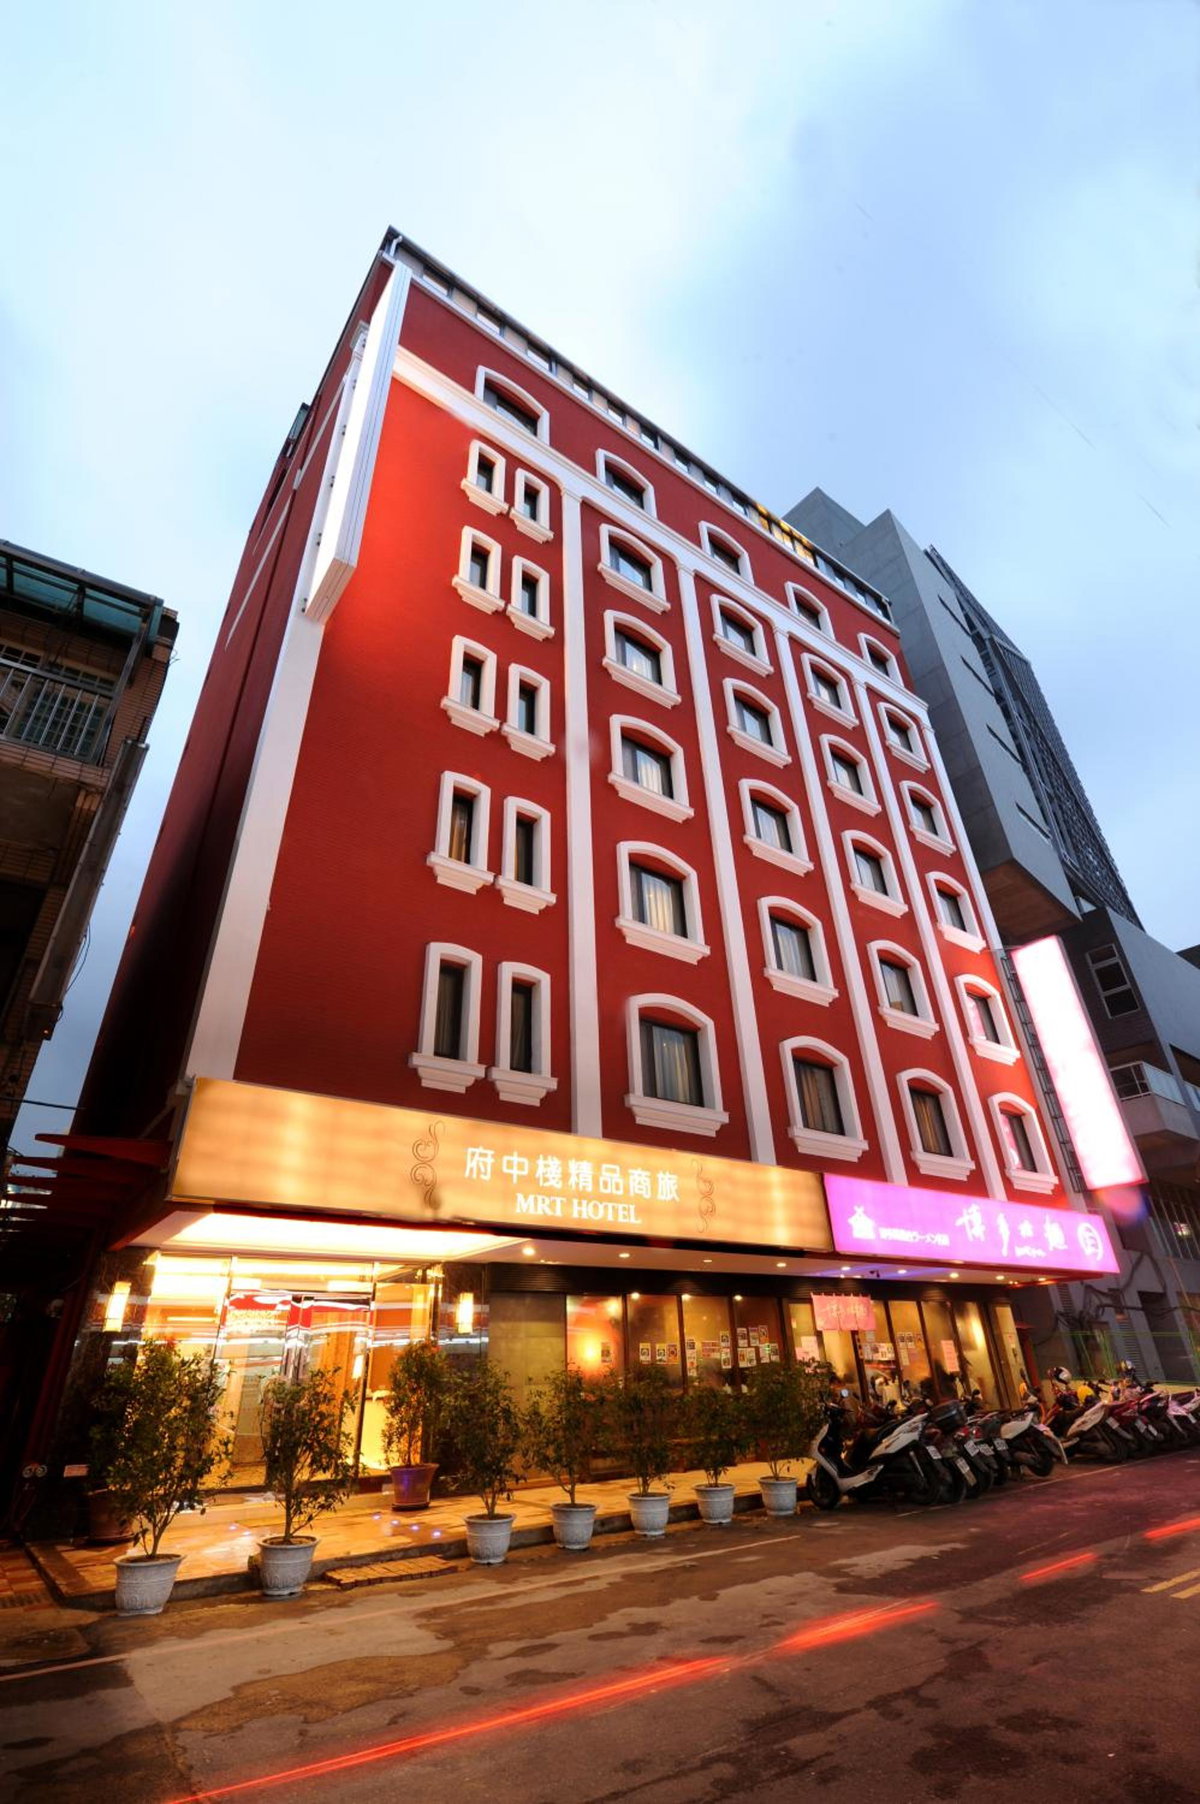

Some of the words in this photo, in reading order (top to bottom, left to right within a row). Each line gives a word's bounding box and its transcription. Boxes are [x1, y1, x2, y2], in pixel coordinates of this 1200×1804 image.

[464, 1146, 679, 1202] 府中棧精品商旅
[515, 1193, 565, 1217] MRT
[572, 1199, 641, 1224] HOTEL
